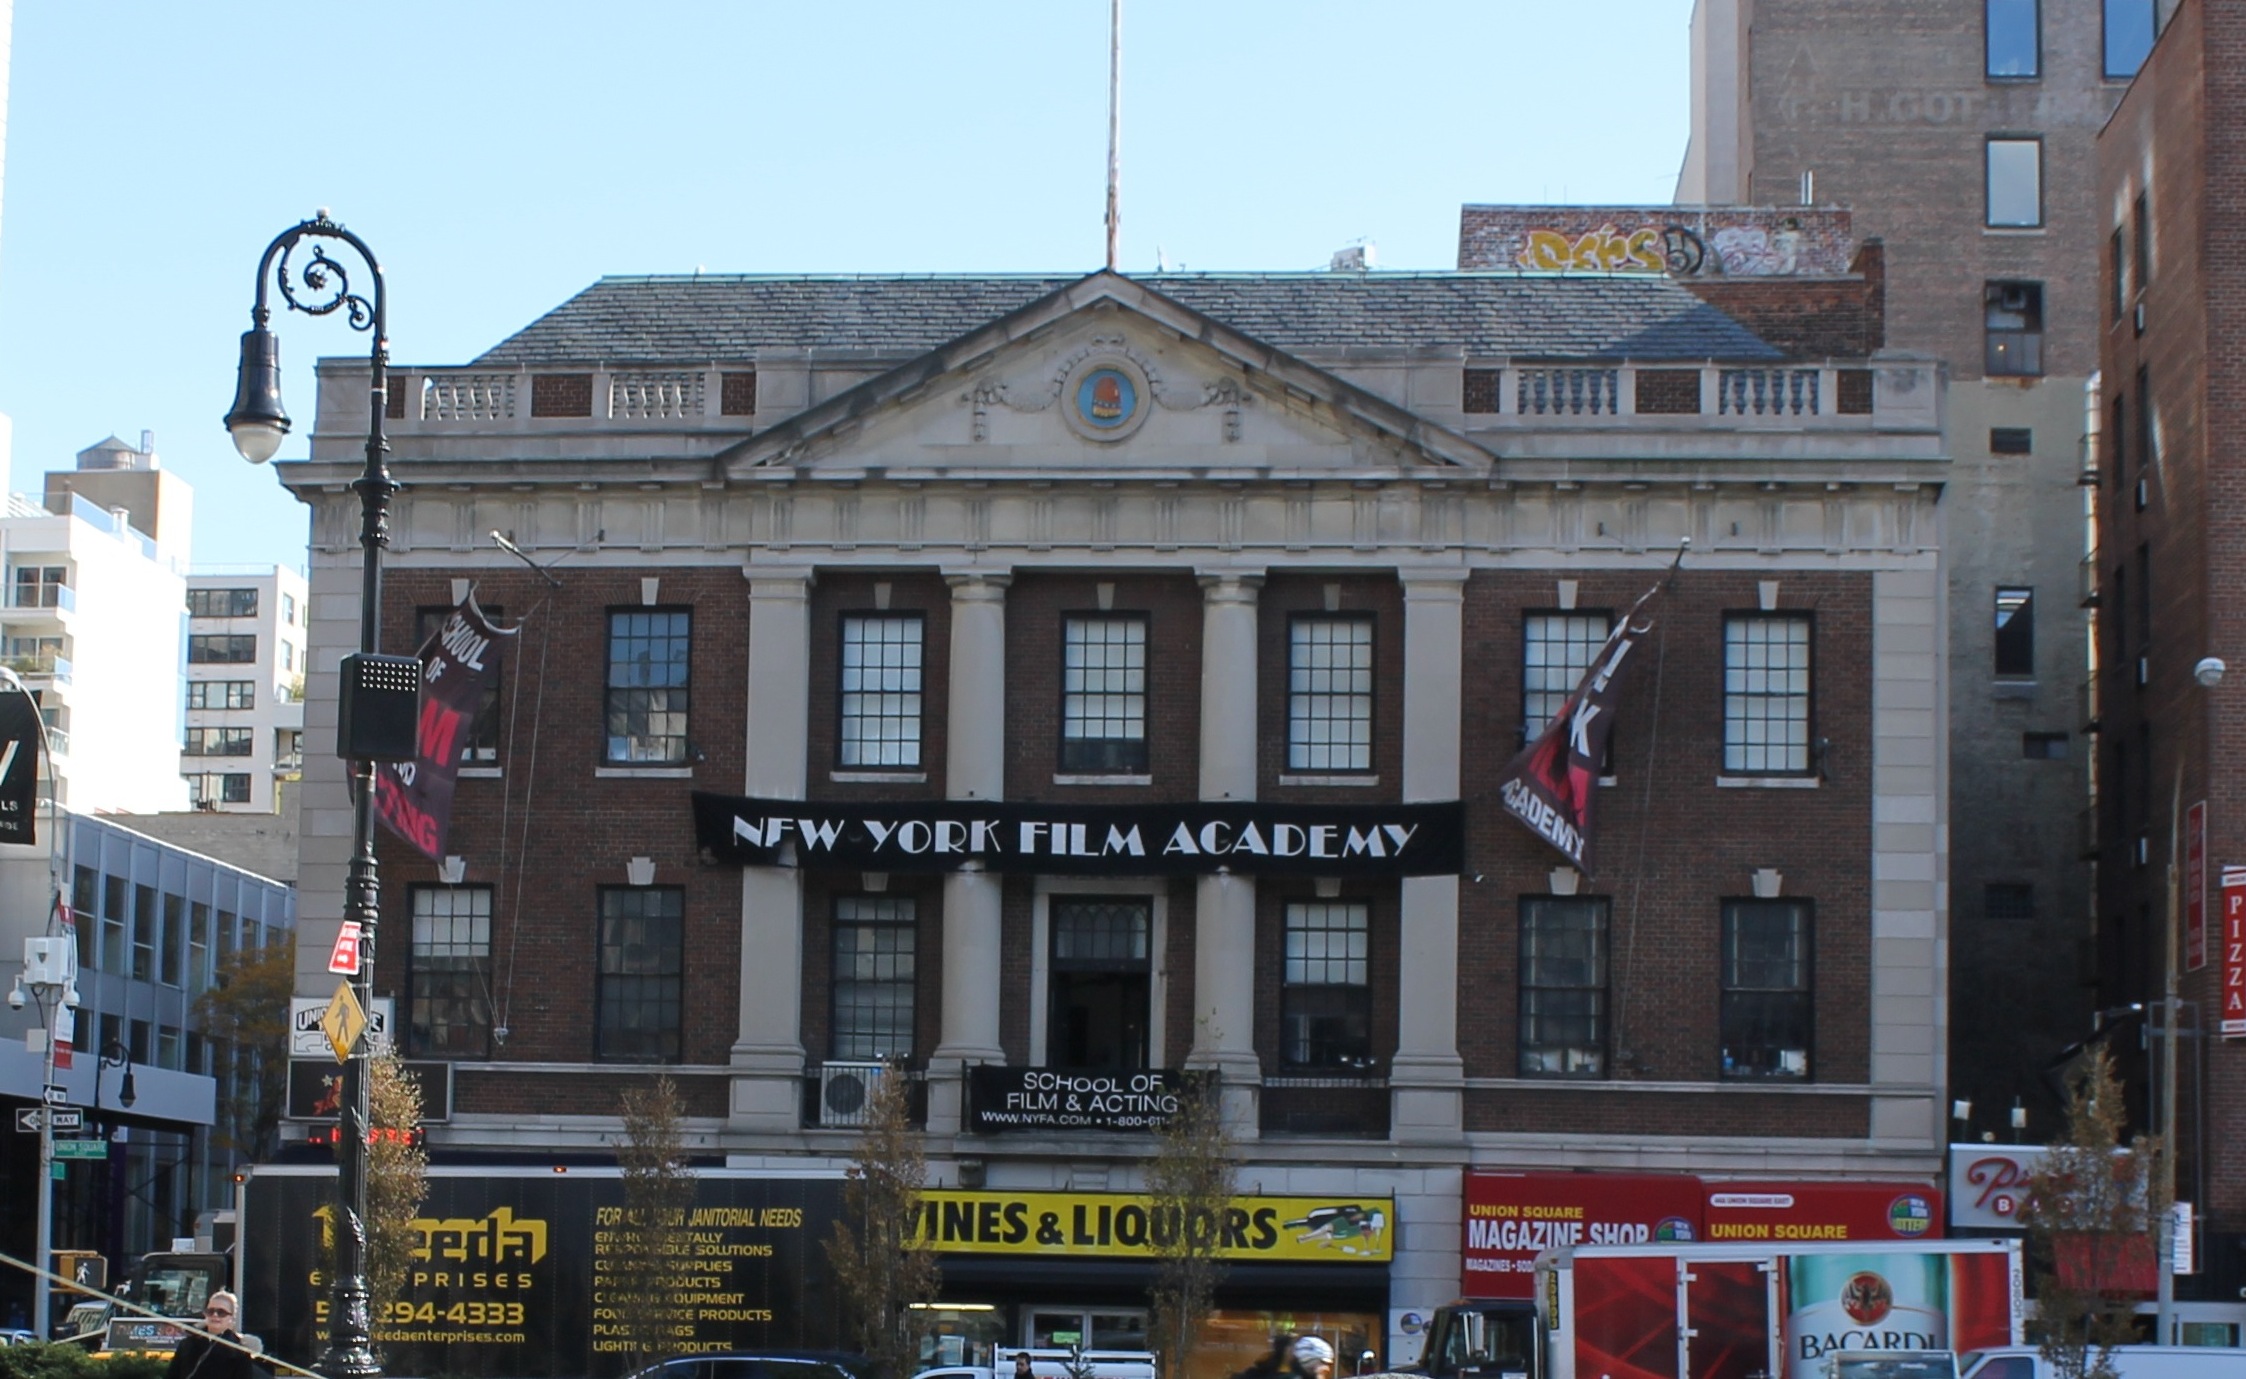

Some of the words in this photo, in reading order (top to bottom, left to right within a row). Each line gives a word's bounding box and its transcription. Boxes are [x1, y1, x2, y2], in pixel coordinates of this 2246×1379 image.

[441, 614, 489, 671] CHOOL
[425, 657, 447, 683] OF
[863, 820, 1000, 853] YORK
[1020, 821, 1145, 856] FILM
[1163, 820, 1418, 857] ACADEMY
[2229, 895, 2243, 1011] PIZZA
[1023, 1071, 1123, 1093] SCHOOL
[1131, 1074, 1163, 1092] OF
[1006, 1092, 1058, 1110] FILM
[1065, 1094, 1082, 1112] &
[1088, 1094, 1178, 1113] ACTING
[981, 1111, 1091, 1125] WWW.NYFA.COM
[1106, 1116, 1171, 1127] 1-800-611-
[595, 1207, 621, 1226] FOR
[688, 1208, 756, 1227] JANITORIAL
[760, 1208, 803, 1227] NEEDS
[1470, 1204, 1518, 1217] UNION
[1523, 1206, 1583, 1219] SQUARE
[1035, 1211, 1064, 1245] &
[1073, 1205, 1278, 1250] LIQUORS
[1468, 1218, 1583, 1251] MAGAZINE
[1590, 1222, 1649, 1244] SHOP
[1711, 1224, 1769, 1238] UNION
[1774, 1224, 1847, 1239] SQUARE
[694, 1245, 773, 1257] SOLUTIONS
[1516, 1260, 1535, 1272] SOD
[315, 1301, 525, 1325] 5294-4333
[699, 1309, 772, 1321] PRODUCTS
